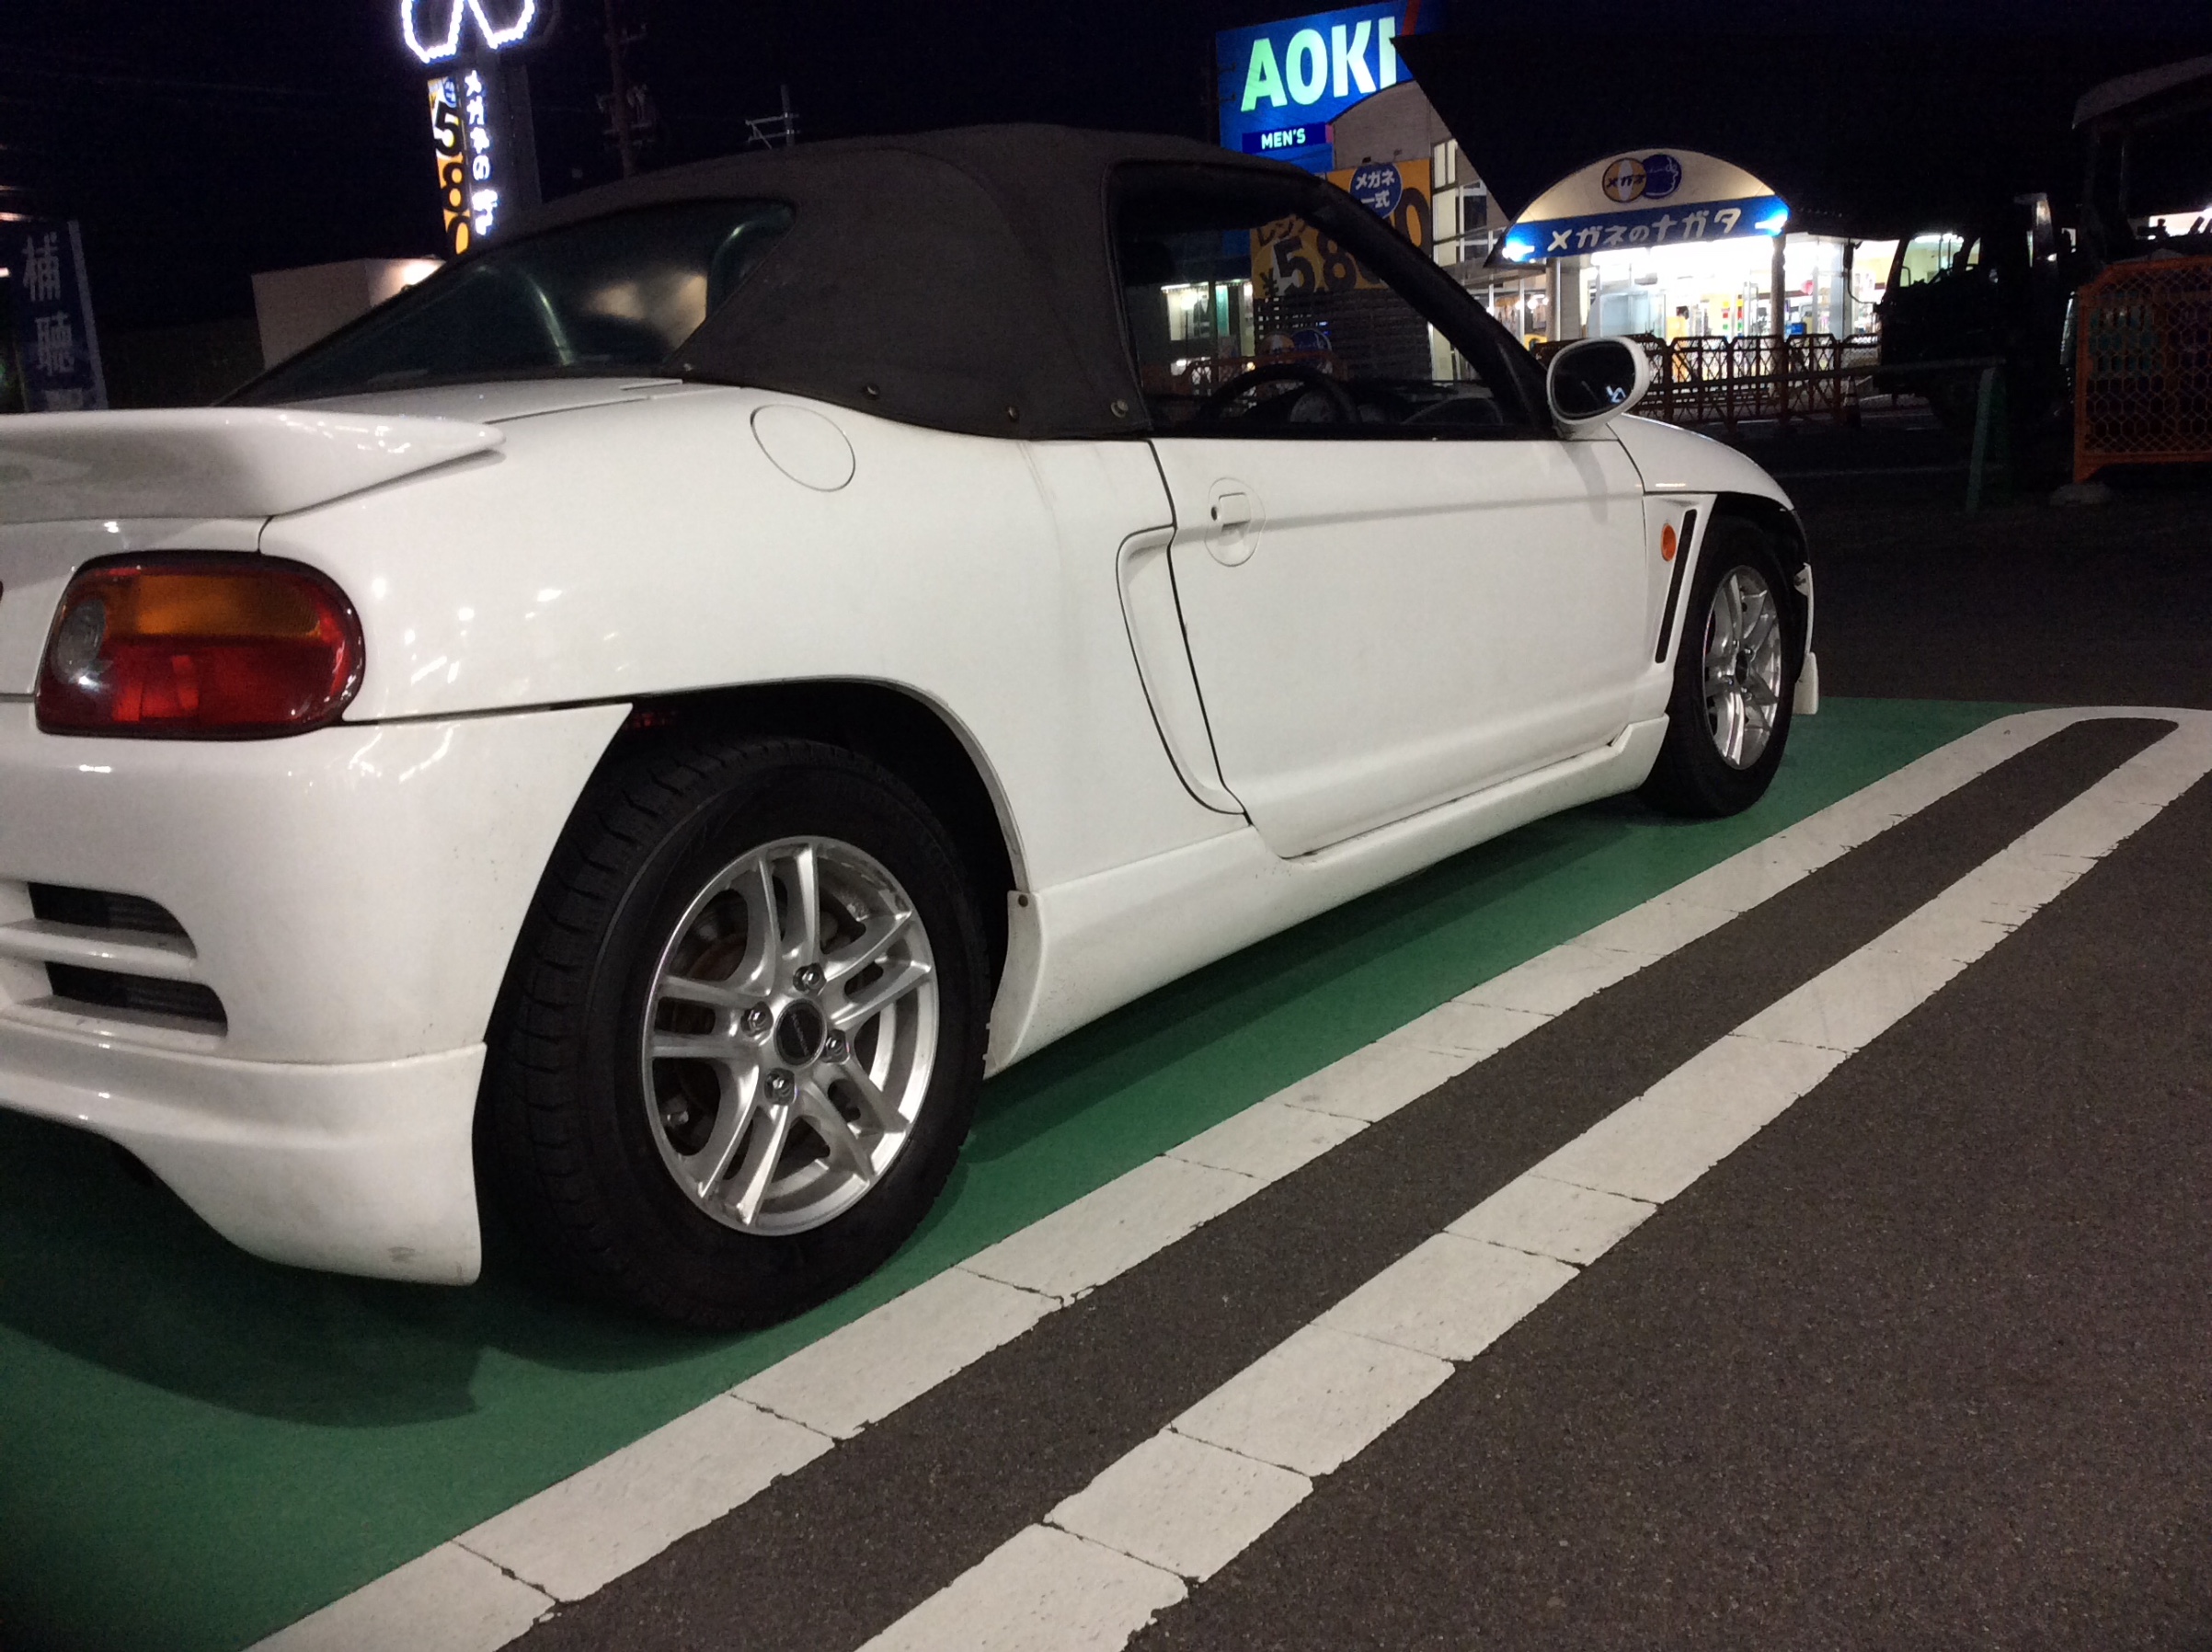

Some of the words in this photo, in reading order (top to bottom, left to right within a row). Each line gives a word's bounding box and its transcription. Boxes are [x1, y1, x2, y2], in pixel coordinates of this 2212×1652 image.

[1241, 16, 1397, 112] AOKI
[1261, 128, 1306, 150] MEN'S
[1356, 169, 1395, 189] メガネ
[1547, 207, 1741, 252] メガネのナガタ
